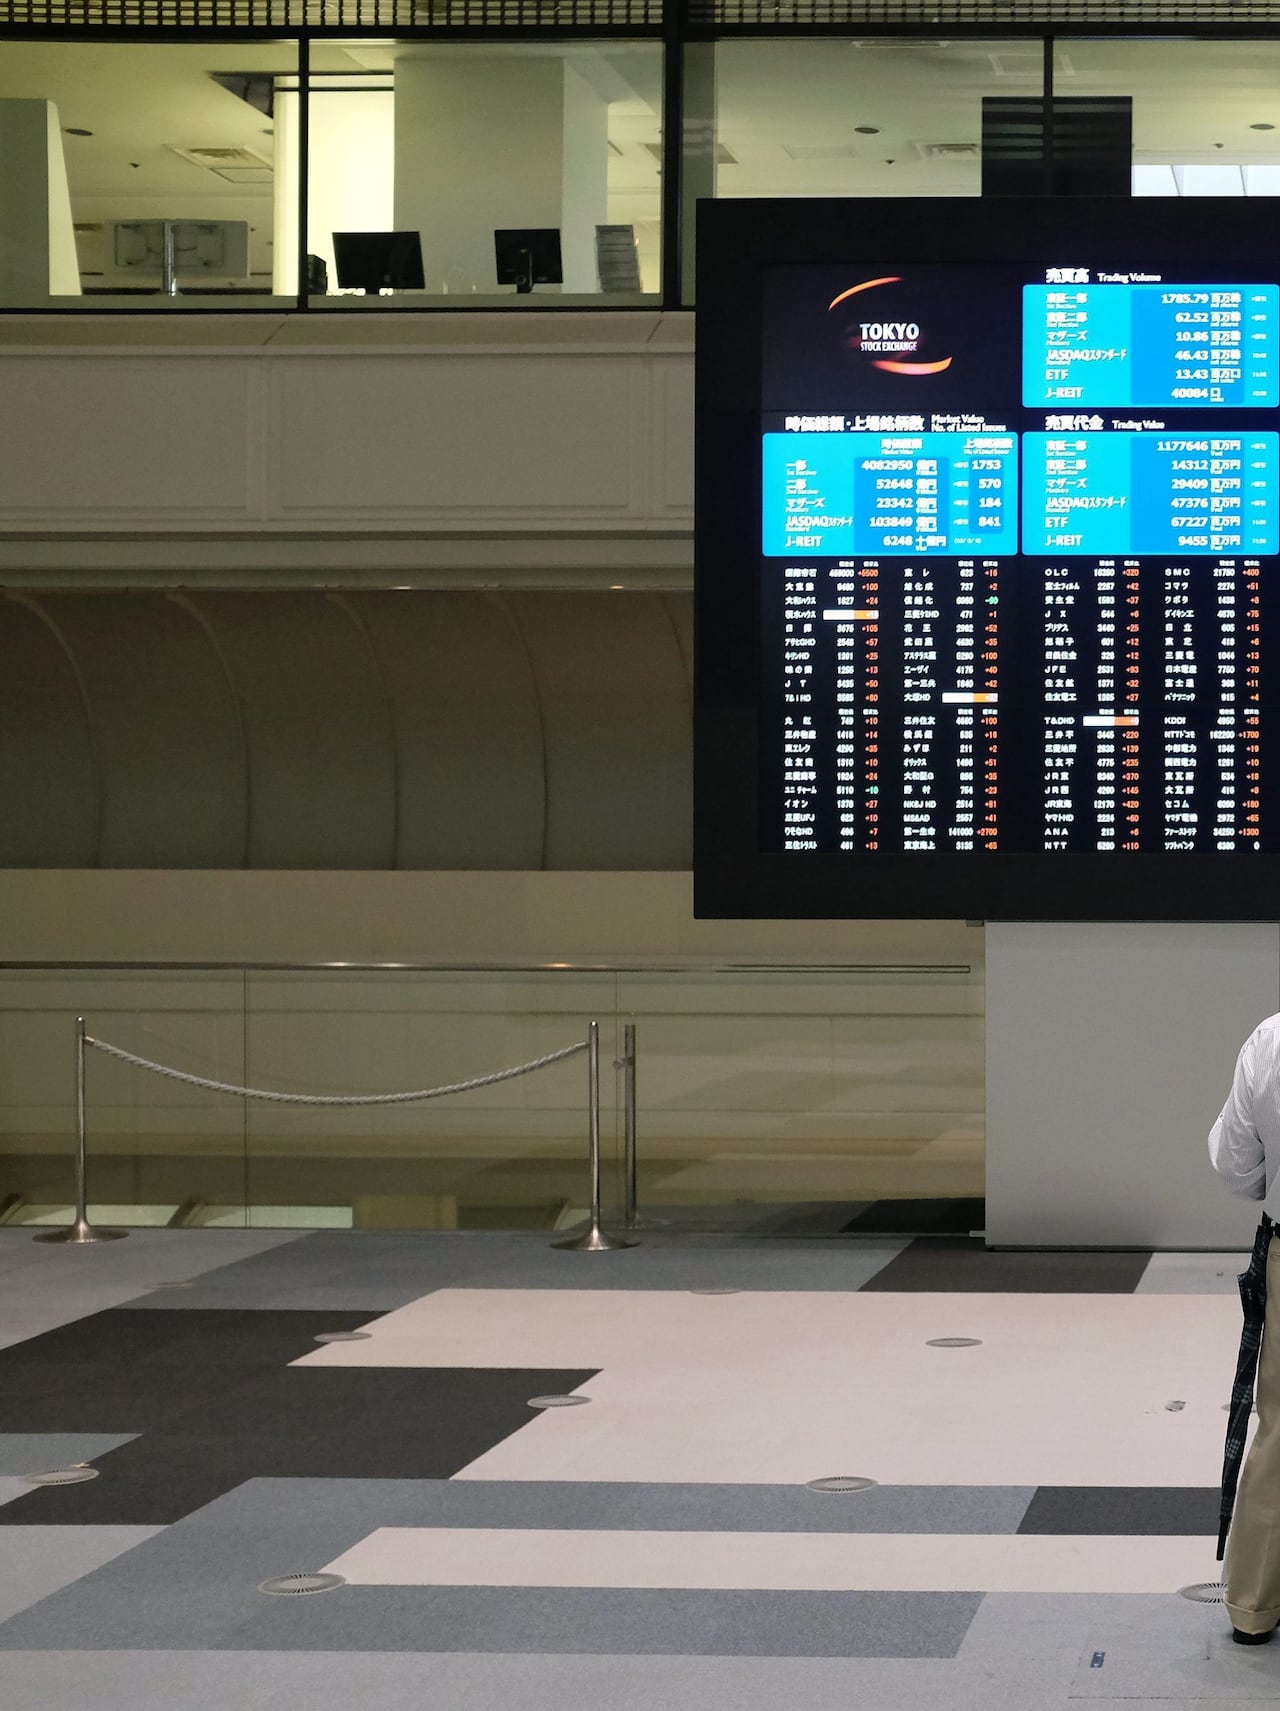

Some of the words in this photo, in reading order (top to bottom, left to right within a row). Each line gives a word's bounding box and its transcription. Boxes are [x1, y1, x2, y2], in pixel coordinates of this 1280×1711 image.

[1097, 273, 1130, 283] Trading
[1129, 273, 1161, 281] Volume
[1162, 294, 1209, 303] 1785.79
[1176, 313, 1208, 322] 62.52
[860, 323, 919, 340] TOKYO
[1176, 332, 1208, 341] 10.86
[860, 341, 883, 351] STOCK
[882, 341, 917, 351] EXCHANGE
[1175, 350, 1208, 360] 46.43
[1046, 369, 1068, 380] ETF
[1176, 369, 1208, 379] 13.43
[1046, 387, 1082, 398] J-REIT
[1171, 388, 1208, 398] 40084
[931, 415, 960, 425] Market
[960, 414, 985, 425] Value
[947, 423, 957, 432] of
[1112, 420, 1143, 431] Trading
[1142, 420, 1165, 429] Value
[1158, 441, 1208, 451] 1177646
[973, 460, 1001, 469] 1753
[1173, 460, 1208, 470] 14312
[877, 479, 913, 489] 52648
[979, 479, 1001, 488] 570
[1172, 479, 1208, 489] 29409
[877, 498, 913, 508] 23342
[980, 498, 1001, 507] 184
[1171, 498, 1208, 508] 47376
[979, 517, 1000, 526] 841
[1046, 517, 1067, 527] ETF
[1171, 517, 1208, 527] 67227
[786, 536, 822, 546] J-REIT
[884, 536, 913, 546] 6248
[1046, 535, 1082, 545] J-REIT
[1179, 536, 1208, 546] 9455
